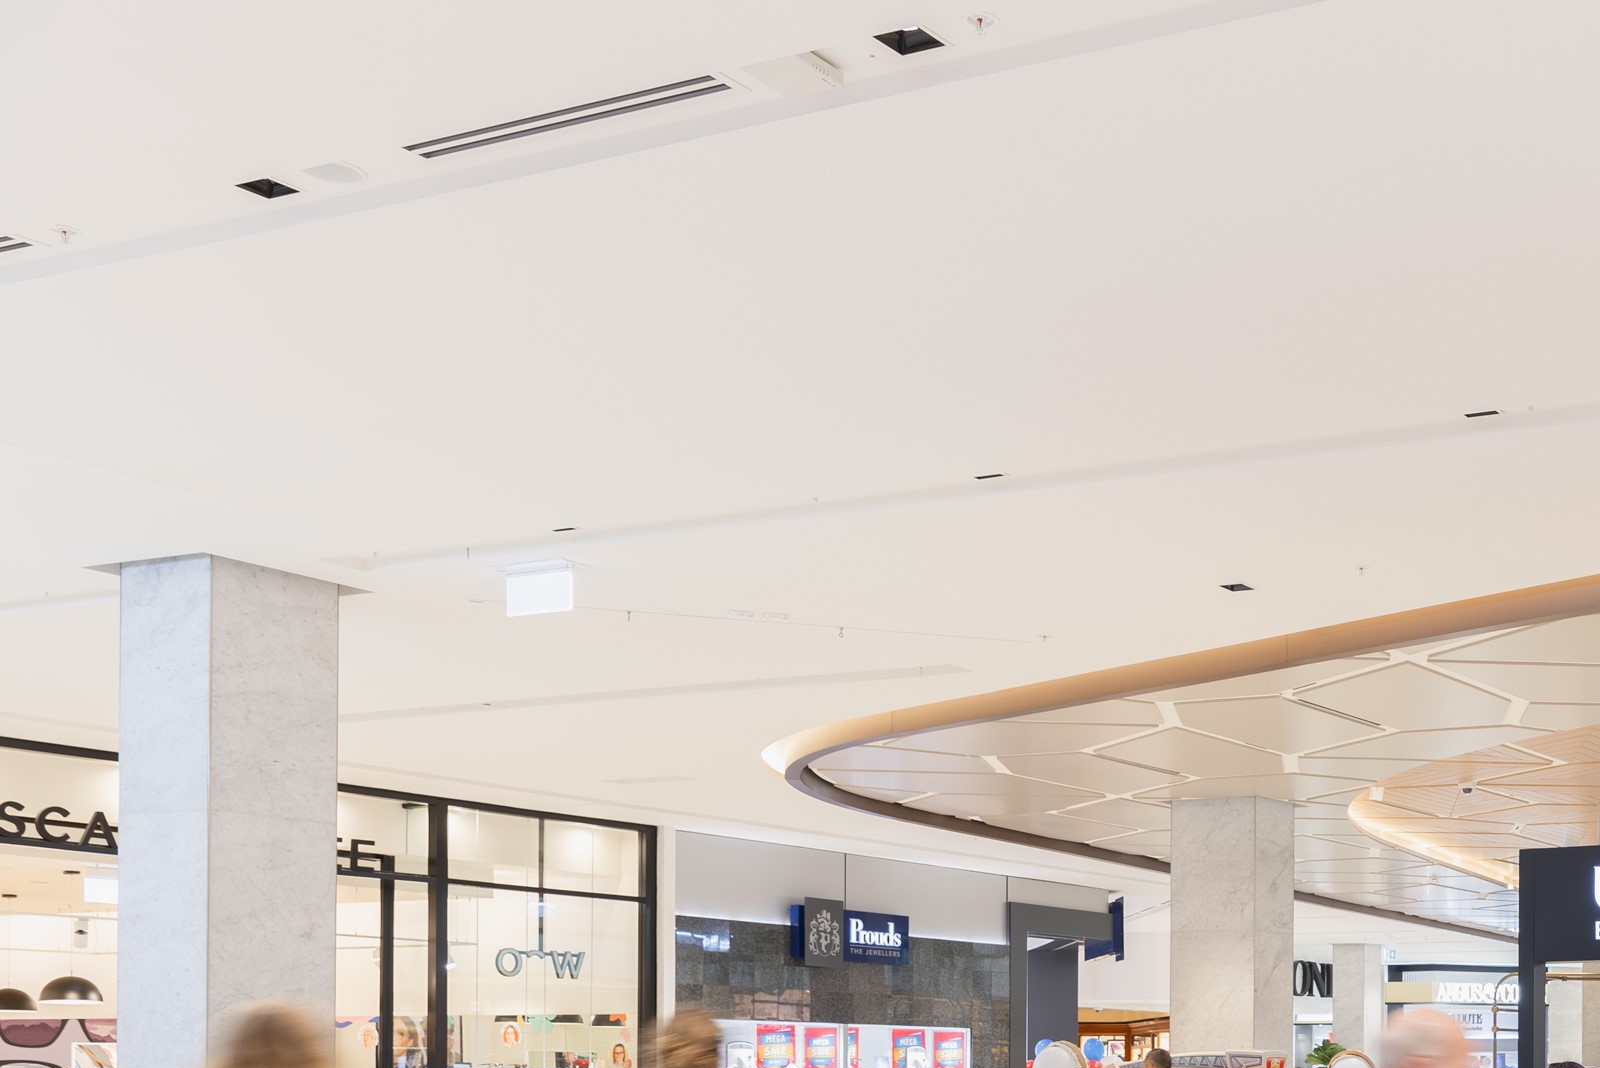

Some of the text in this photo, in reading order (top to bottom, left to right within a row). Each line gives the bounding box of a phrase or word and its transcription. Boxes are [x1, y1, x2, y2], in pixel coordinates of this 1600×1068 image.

[849, 918, 902, 947] Prouds
[849, 947, 901, 957] THE JEWELLERS
[765, 1035, 786, 1043] MEGA
[813, 1038, 830, 1046] MEGA
[900, 1037, 918, 1046] MEGA
[764, 1046, 787, 1056] SALE
